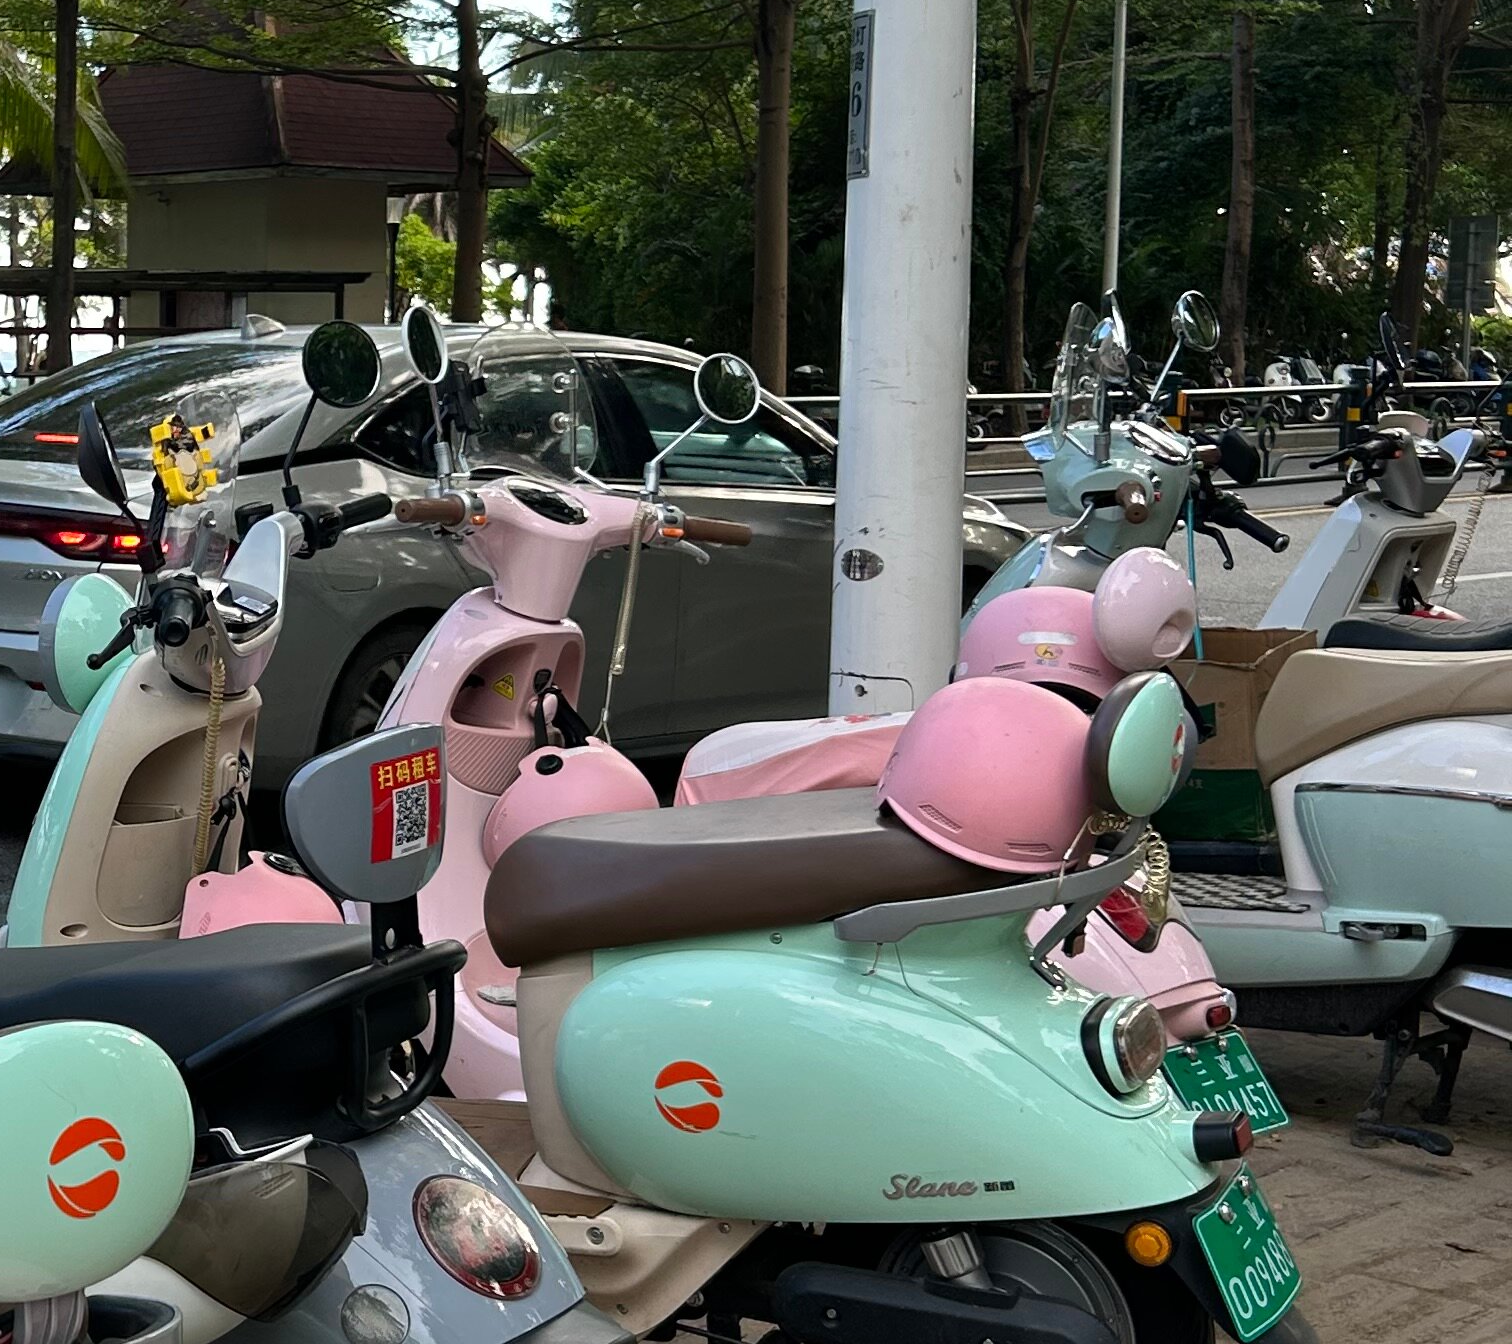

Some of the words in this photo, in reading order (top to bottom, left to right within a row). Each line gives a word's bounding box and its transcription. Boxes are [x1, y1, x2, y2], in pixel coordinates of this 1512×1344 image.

[377, 751, 438, 791] 扫码租车
[1190, 1053, 1239, 1087] 三亚
[882, 1173, 979, 1201] Slane
